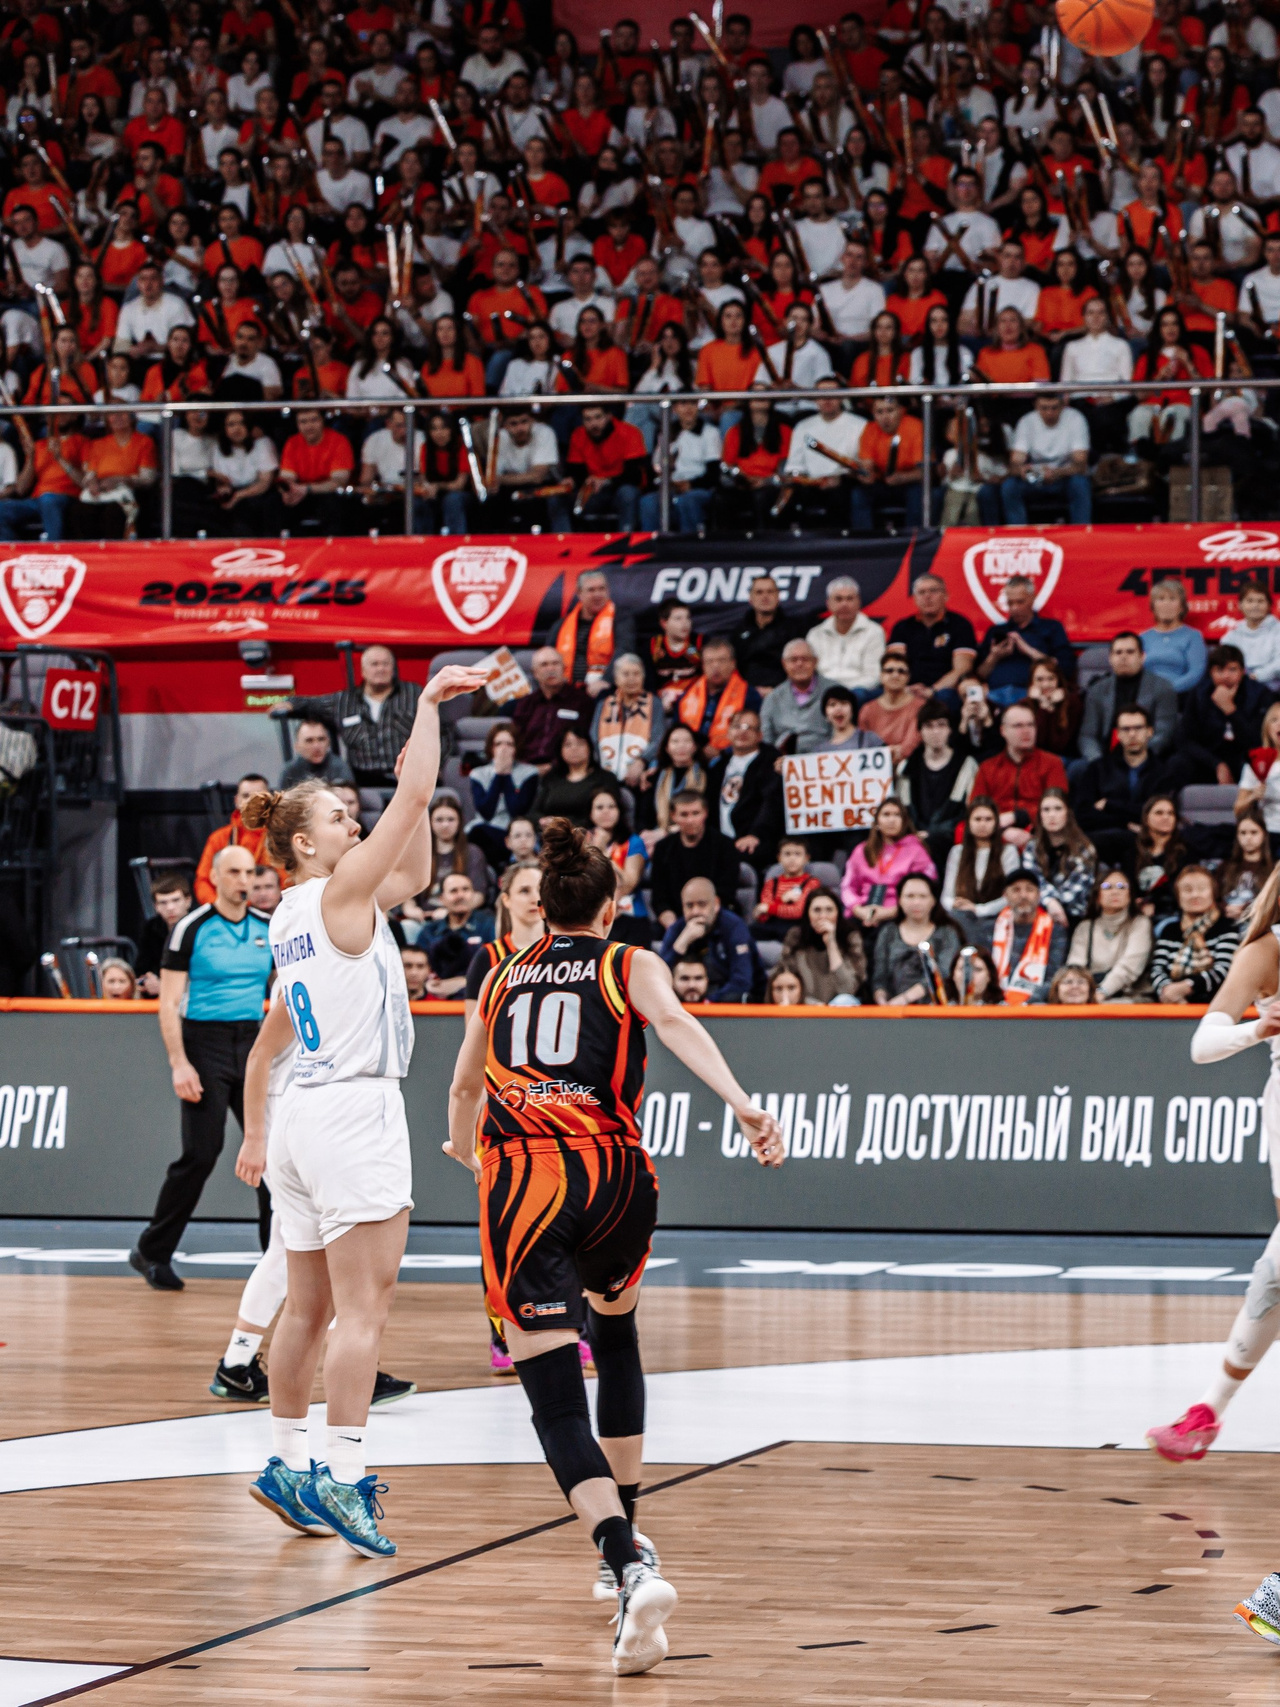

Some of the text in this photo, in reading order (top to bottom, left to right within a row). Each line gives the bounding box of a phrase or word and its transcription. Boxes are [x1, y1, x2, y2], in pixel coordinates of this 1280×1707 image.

[138, 579, 367, 607] 2024/25
[650, 565, 823, 604] FONBET
[50, 678, 97, 721] C12
[785, 751, 885, 782] ALEX 20
[785, 777, 893, 810] BENTLEY
[791, 806, 878, 829] THE BES
[506, 958, 597, 989] ШИЛОВА
[507, 990, 582, 1068] 10
[634, 1090, 691, 1158] ОЛ
[721, 1083, 851, 1159] СМЫЙ
[855, 1086, 1071, 1165] ДОСТУПНЫЙ
[1080, 1096, 1154, 1168] ВИД
